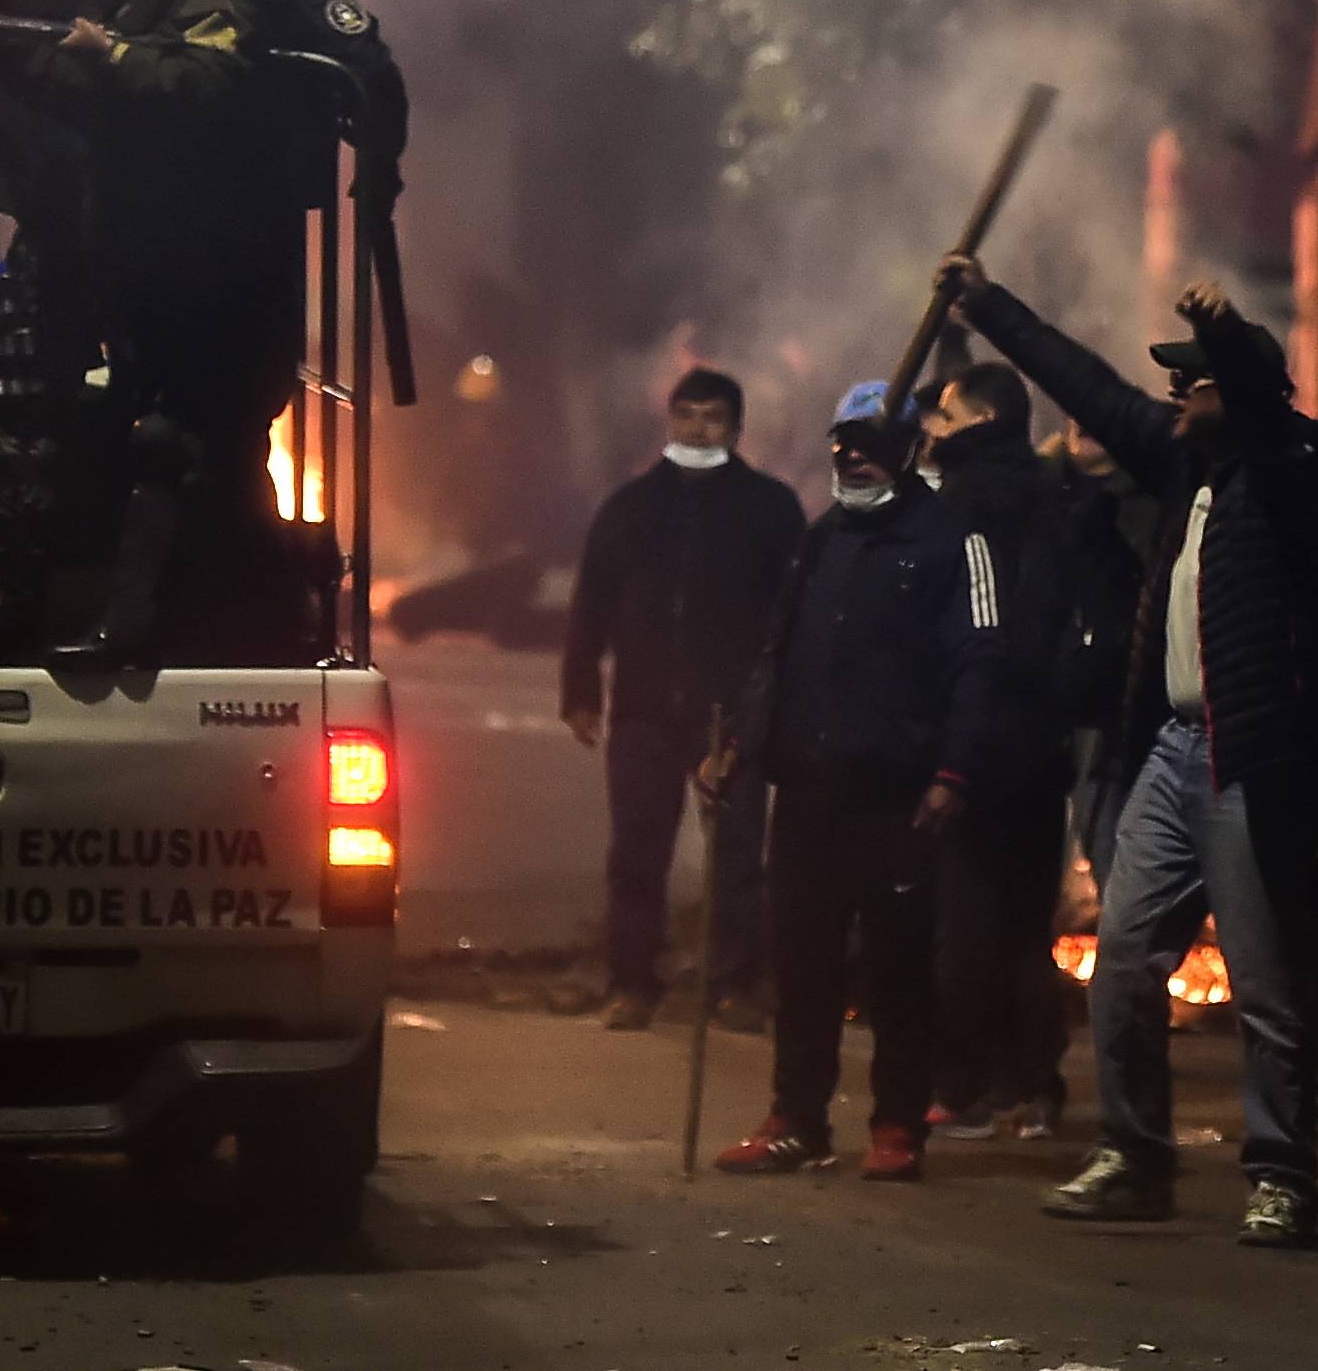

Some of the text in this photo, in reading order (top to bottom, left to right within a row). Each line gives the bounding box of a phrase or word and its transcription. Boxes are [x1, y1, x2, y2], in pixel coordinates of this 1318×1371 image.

[17, 827, 268, 868] EXCLUSIVA
[68, 886, 125, 927] DE
[140, 886, 197, 927] LA
[210, 886, 293, 928] PAZ
